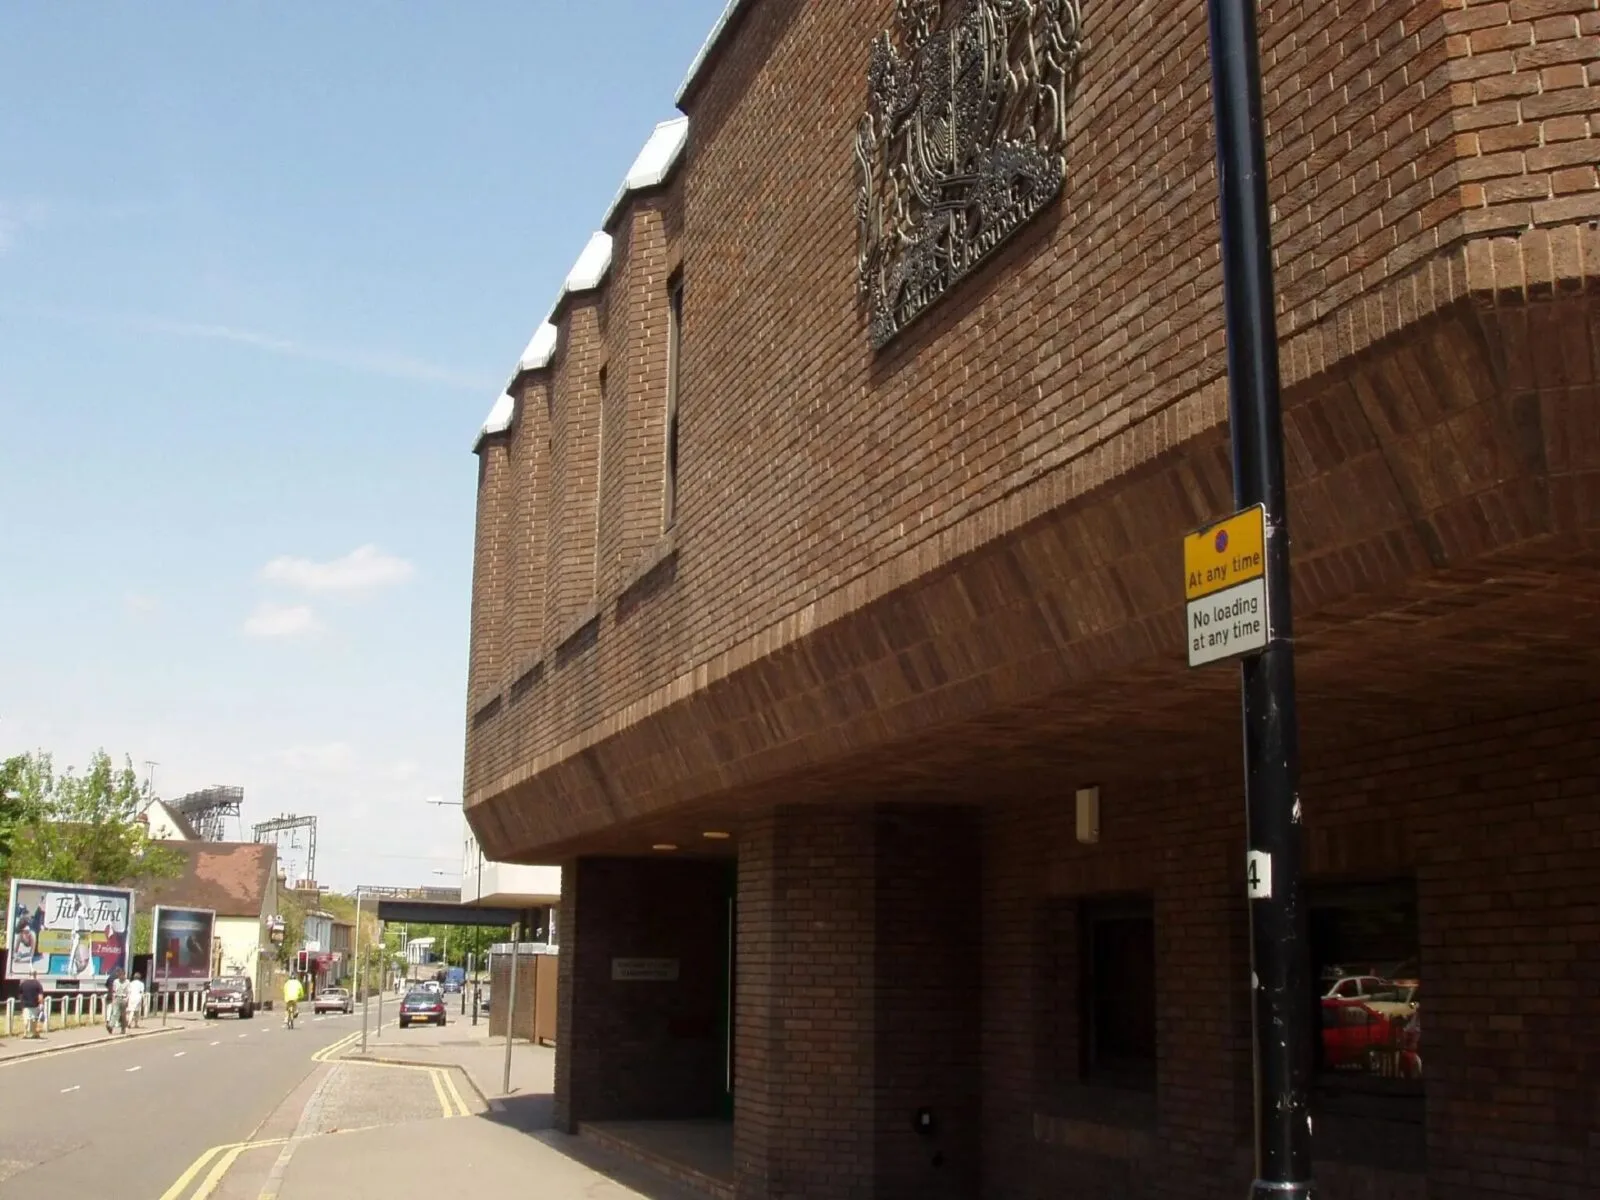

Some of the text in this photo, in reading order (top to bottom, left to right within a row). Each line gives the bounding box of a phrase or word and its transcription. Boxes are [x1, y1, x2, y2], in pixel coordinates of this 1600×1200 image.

[1189, 552, 1261, 589] At any time
[1193, 597, 1258, 629] No loading
[1193, 619, 1261, 651] at any time
[1248, 859, 1261, 890] 4
[94, 900, 122, 925] First
